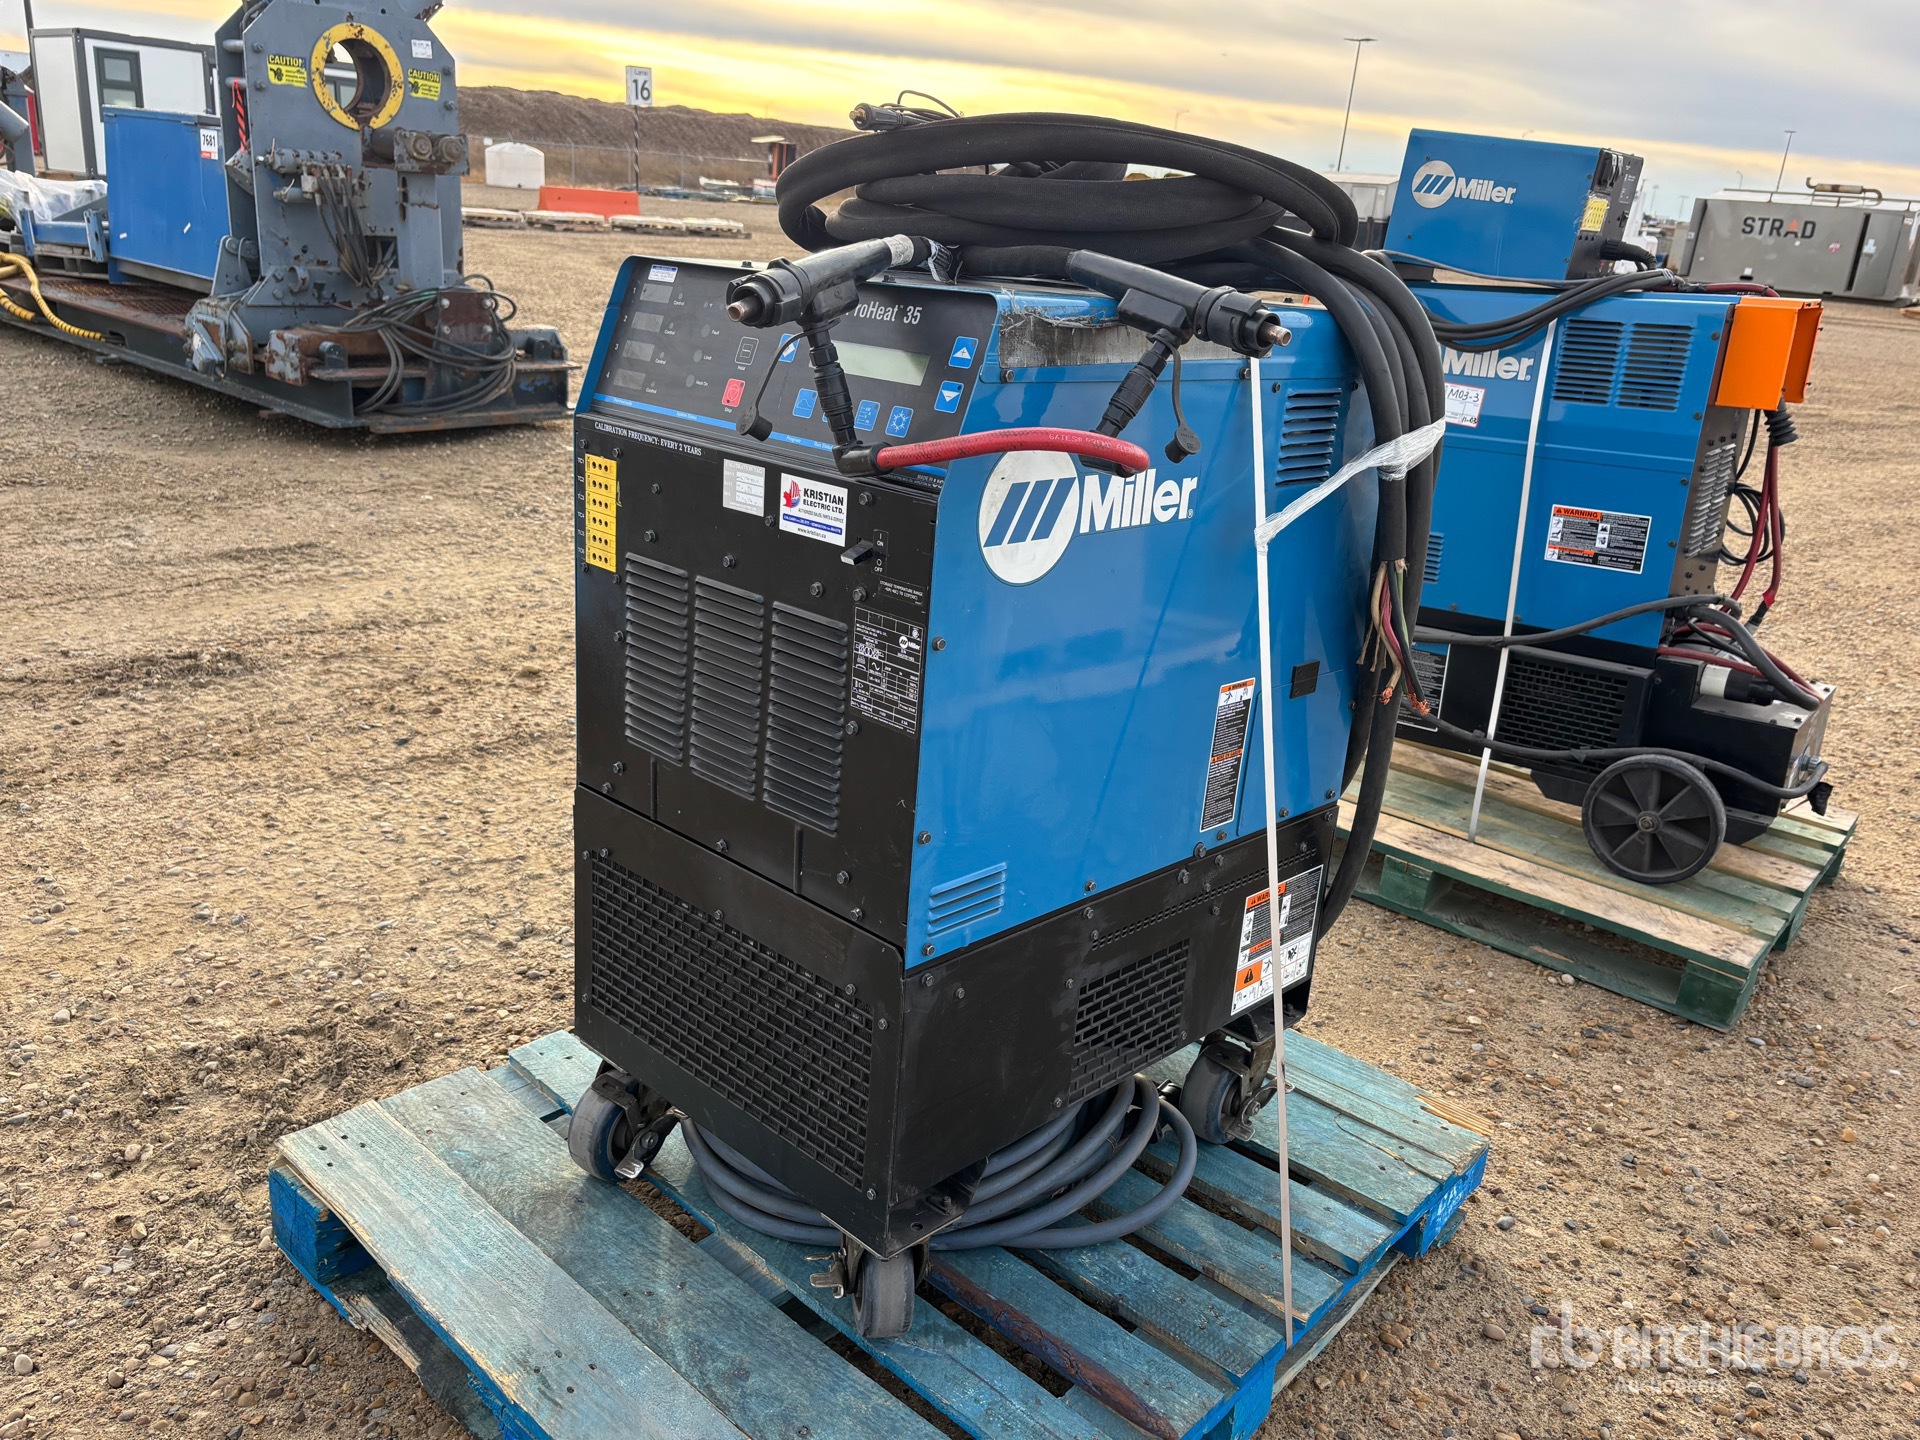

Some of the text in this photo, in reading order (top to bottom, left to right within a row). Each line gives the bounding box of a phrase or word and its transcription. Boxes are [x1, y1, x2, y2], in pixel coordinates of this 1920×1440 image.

[407, 68, 440, 83] CAUTION
[632, 79, 650, 100] 16
[202, 134, 216, 147] 7681
[1741, 216, 1816, 239] STRAD
[904, 306, 922, 324] 35
[1447, 388, 1480, 403] M03-3
[594, 421, 702, 456] CALIBRATION FREQUENCY: EVERY 2 YEARS
[803, 487, 844, 506] KRISTIAN
[803, 498, 845, 515] ELECTRIC LTD.
[1563, 508, 1598, 519] WARNING
